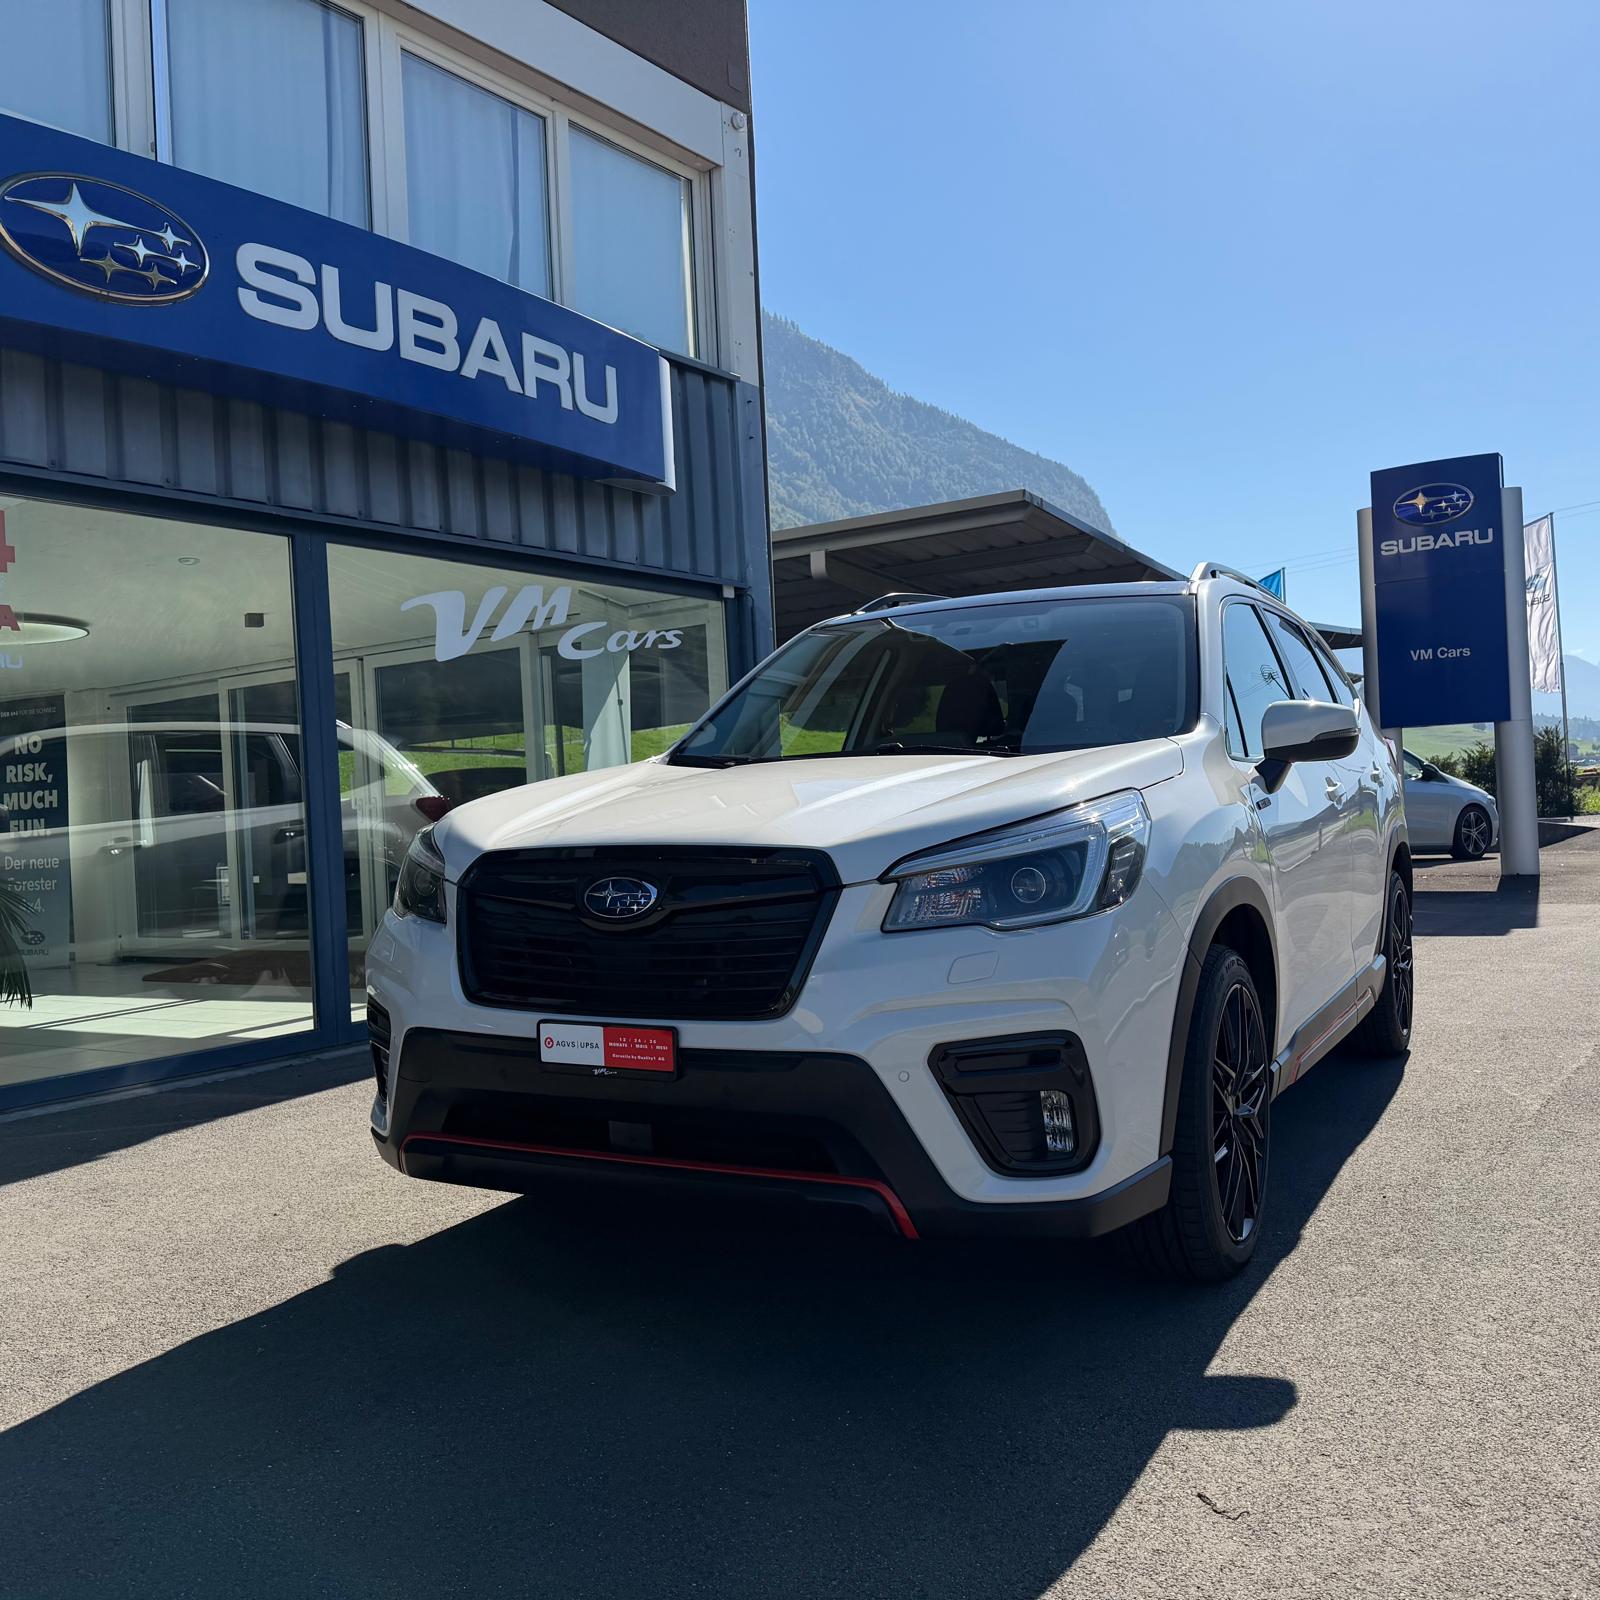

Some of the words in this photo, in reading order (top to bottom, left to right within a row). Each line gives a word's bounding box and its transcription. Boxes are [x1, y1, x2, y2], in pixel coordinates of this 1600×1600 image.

[235, 242, 619, 425] SUBARU
[1380, 527, 1494, 556] SUBARU
[399, 585, 572, 662] VM
[557, 621, 684, 660] Cars
[1410, 648, 1433, 661] VM
[1437, 646, 1471, 659] Cars
[14, 735, 43, 755] NO
[6, 762, 53, 783] RISK,
[3, 789, 58, 811] MUCH
[9, 818, 53, 839] FUN.
[4, 855, 27, 870] Der
[29, 857, 60, 870] neue
